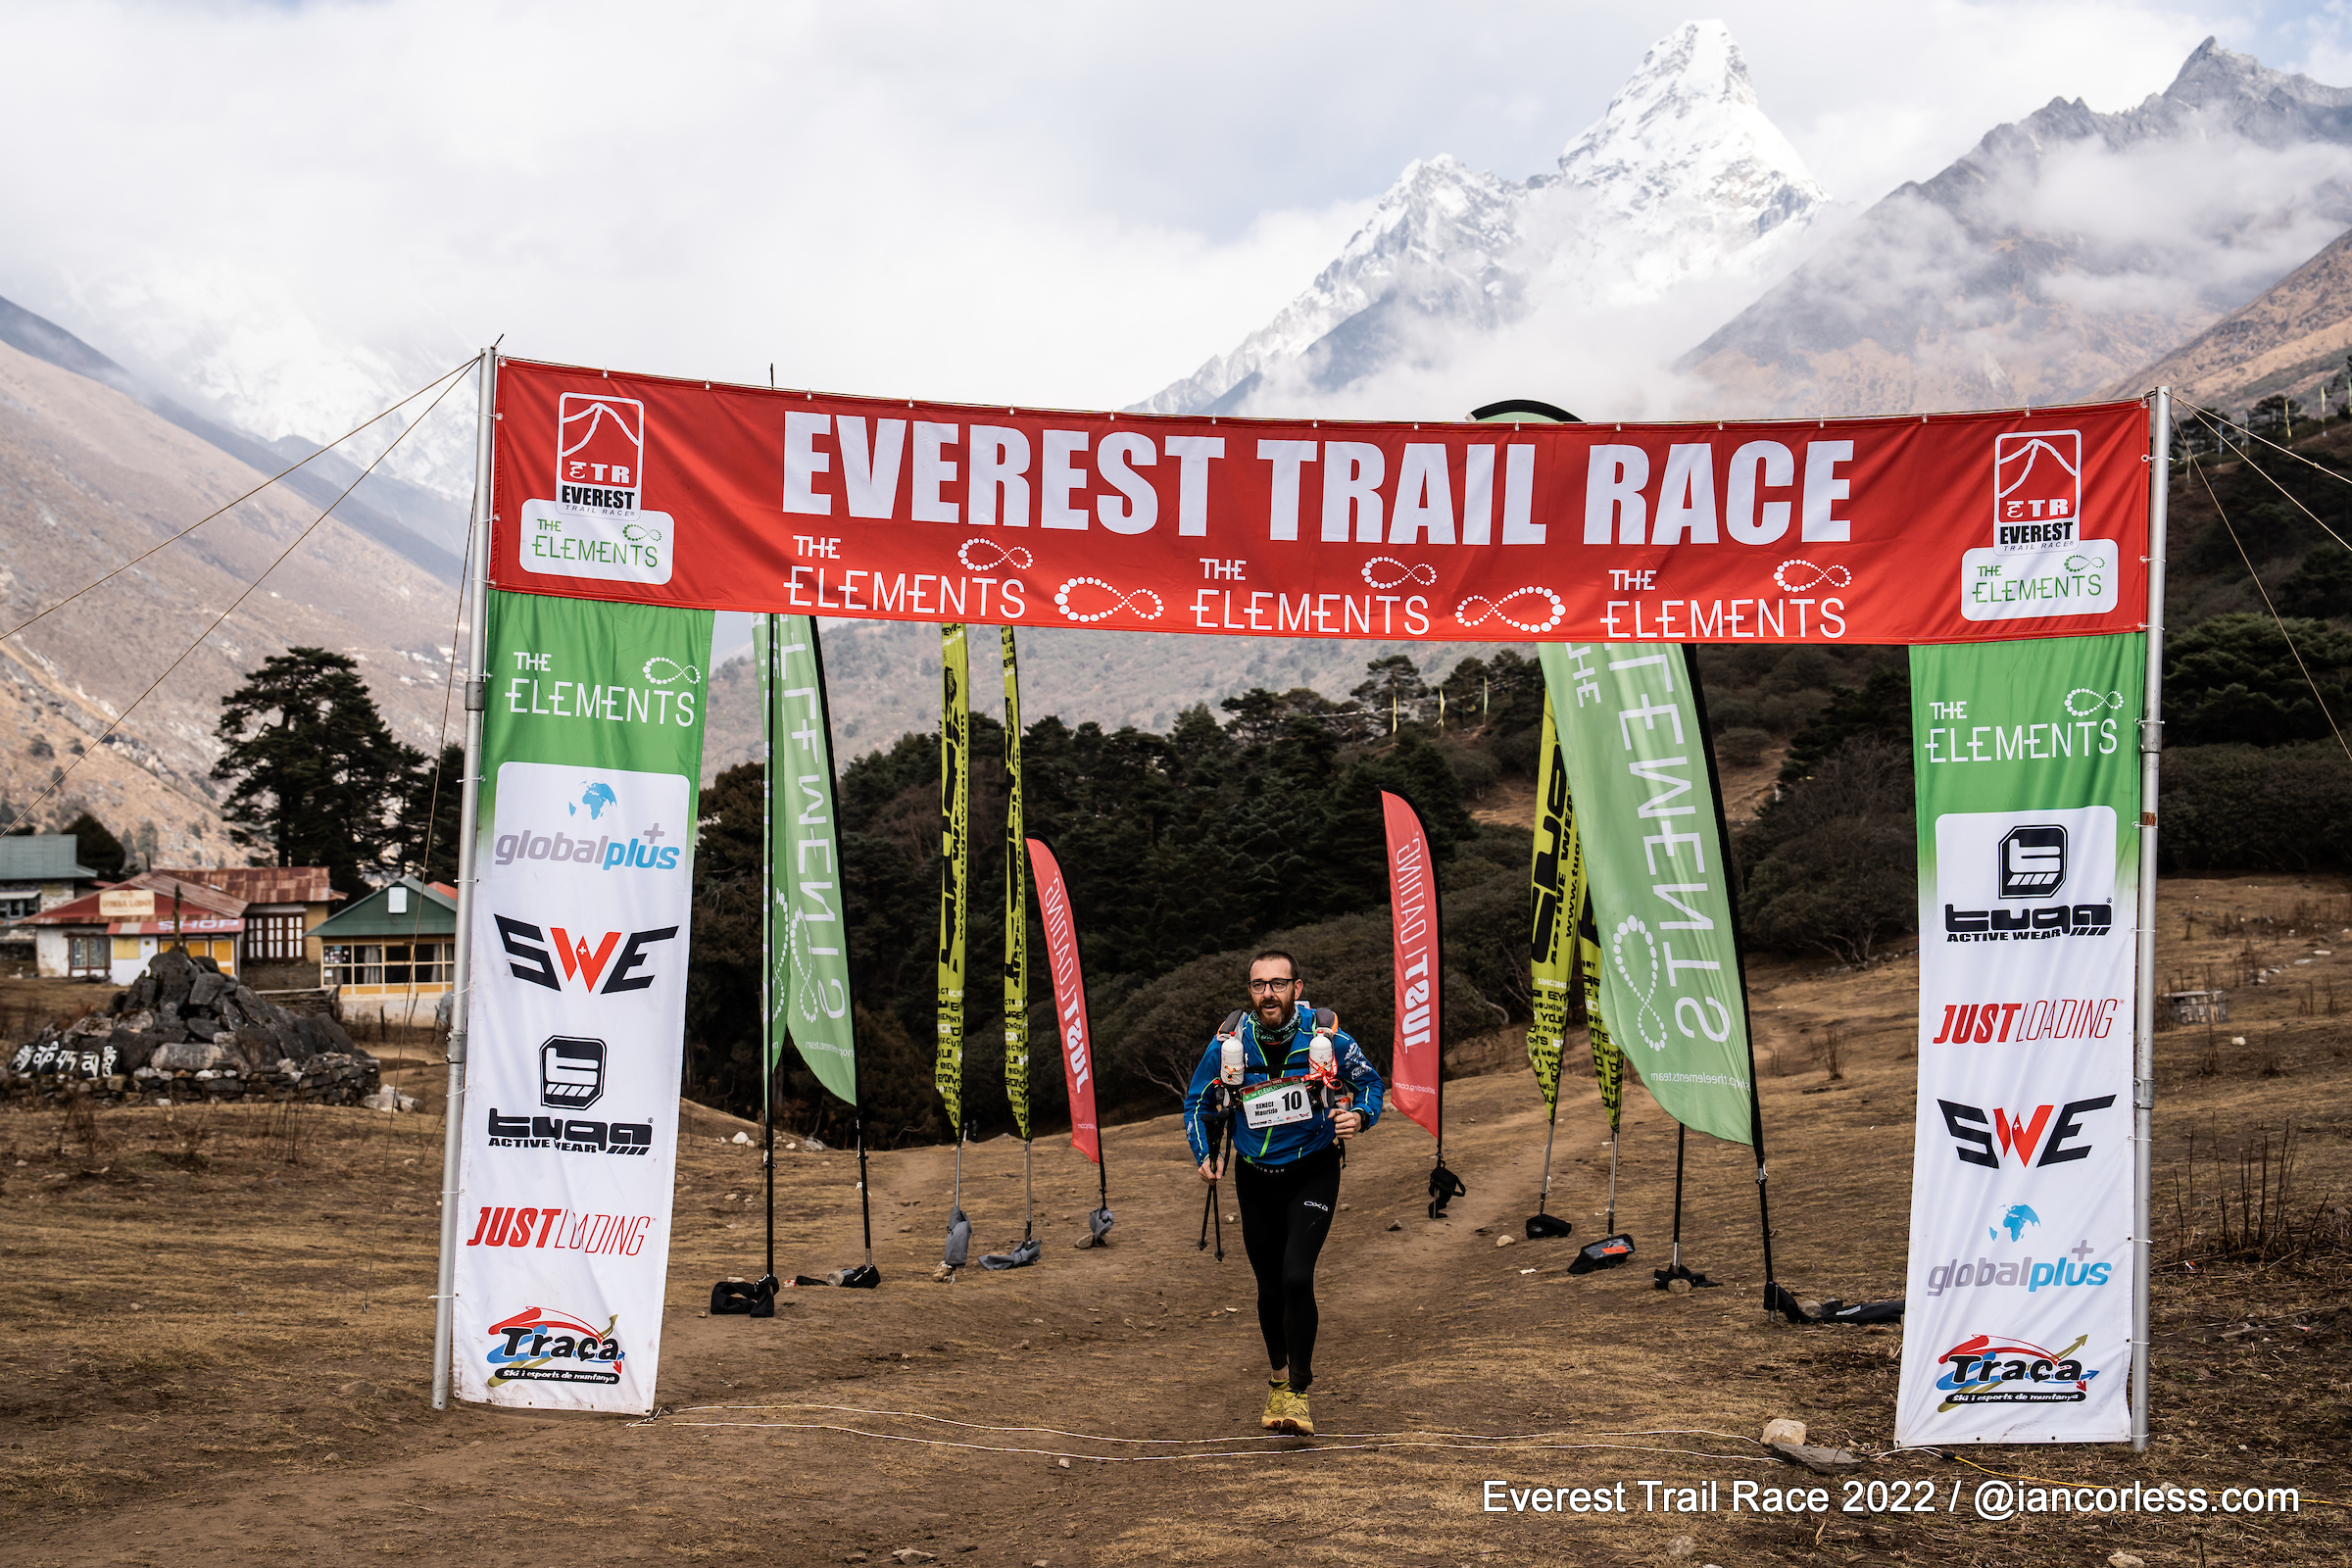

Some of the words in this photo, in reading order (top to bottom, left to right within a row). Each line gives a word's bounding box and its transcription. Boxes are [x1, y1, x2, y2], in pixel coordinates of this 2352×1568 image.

[783, 410, 1226, 537] EVEREST
[1256, 439, 1547, 546] TRAIL
[1583, 439, 1854, 546] RACE
[562, 484, 635, 510] EVEREST
[565, 505, 596, 514] TRAIL
[536, 518, 562, 532] THE
[1999, 521, 2074, 545] EVEREST
[531, 535, 658, 567] ELEMENTS
[793, 534, 841, 560] THE
[1199, 558, 1248, 581] THE
[1608, 569, 1657, 591] THE
[1977, 565, 2002, 577] THE
[783, 565, 1026, 620] ELEMENTS
[1972, 573, 2102, 604] ELEMENTS
[1189, 589, 1430, 635] ELEMENTS
[1599, 597, 1846, 639] ELEMENTS
[514, 651, 552, 672] THE
[505, 677, 696, 727] ELEMENTS
[1930, 701, 1968, 720] THE
[1924, 717, 2118, 763] ELEMENTS
[158, 919, 239, 931] SHOP
[1549, 871, 1567, 966] ACTIVE
[1946, 932, 2009, 943] ACTIVE
[2013, 928, 2061, 941] WEAR
[494, 913, 679, 995] SWE
[1281, 1090, 1303, 1112] 10
[488, 1137, 551, 1149] ACTIVE
[1936, 1094, 2117, 1169] SWE
[501, 1327, 619, 1362] Traça
[526, 1370, 560, 1381] esports
[573, 1374, 615, 1384] muntanya
[1948, 1354, 2083, 1383] Traça
[2030, 1393, 2079, 1402] muntanya
